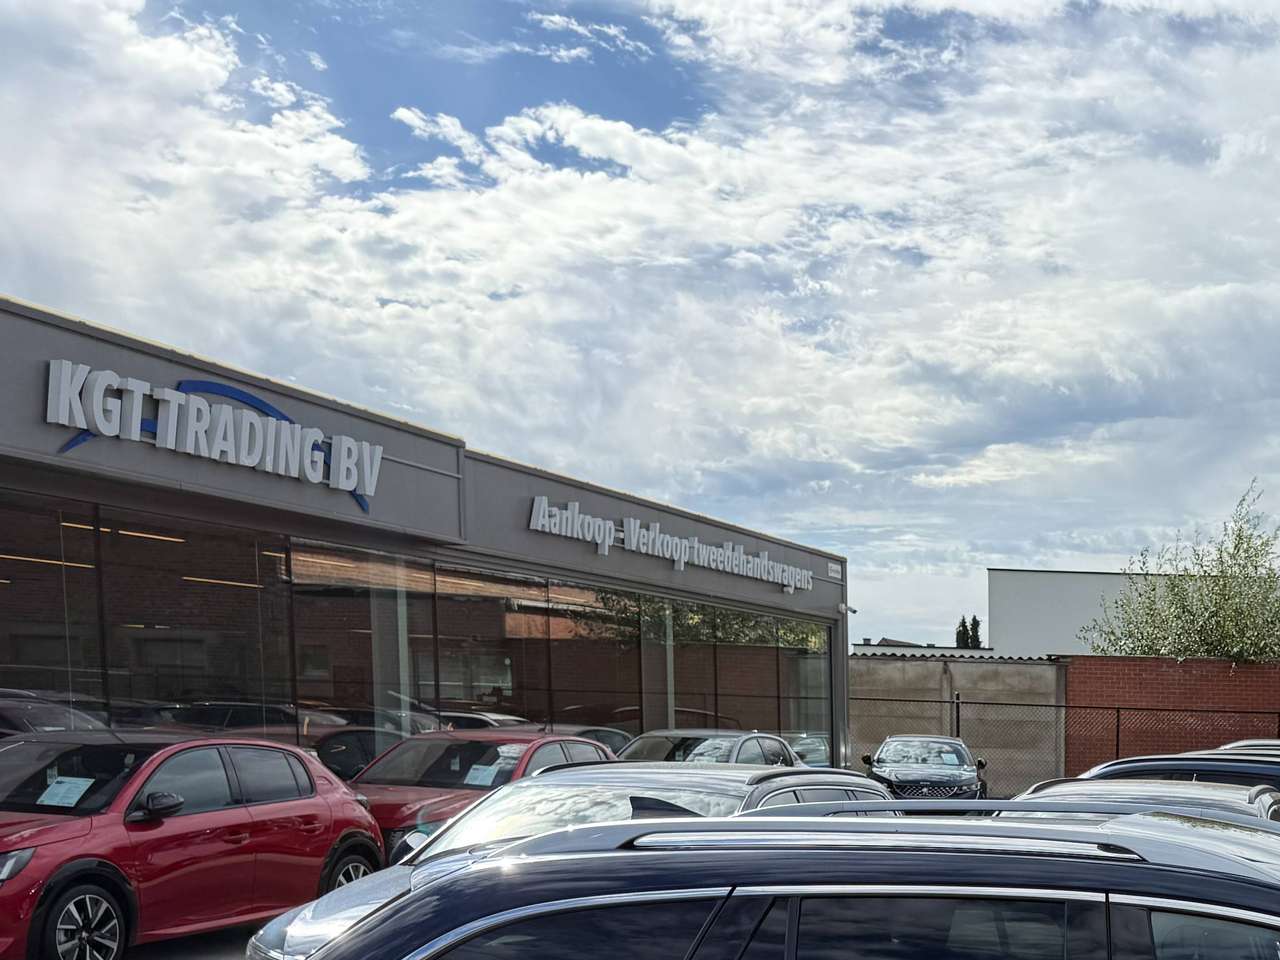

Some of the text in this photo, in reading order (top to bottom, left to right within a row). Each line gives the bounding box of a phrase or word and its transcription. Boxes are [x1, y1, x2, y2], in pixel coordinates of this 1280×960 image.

[47, 359, 384, 497] KGT TRADING BV
[529, 496, 615, 555] Aankoop
[624, 517, 689, 571] Verkoop
[689, 536, 813, 594] tweedehandswagens
